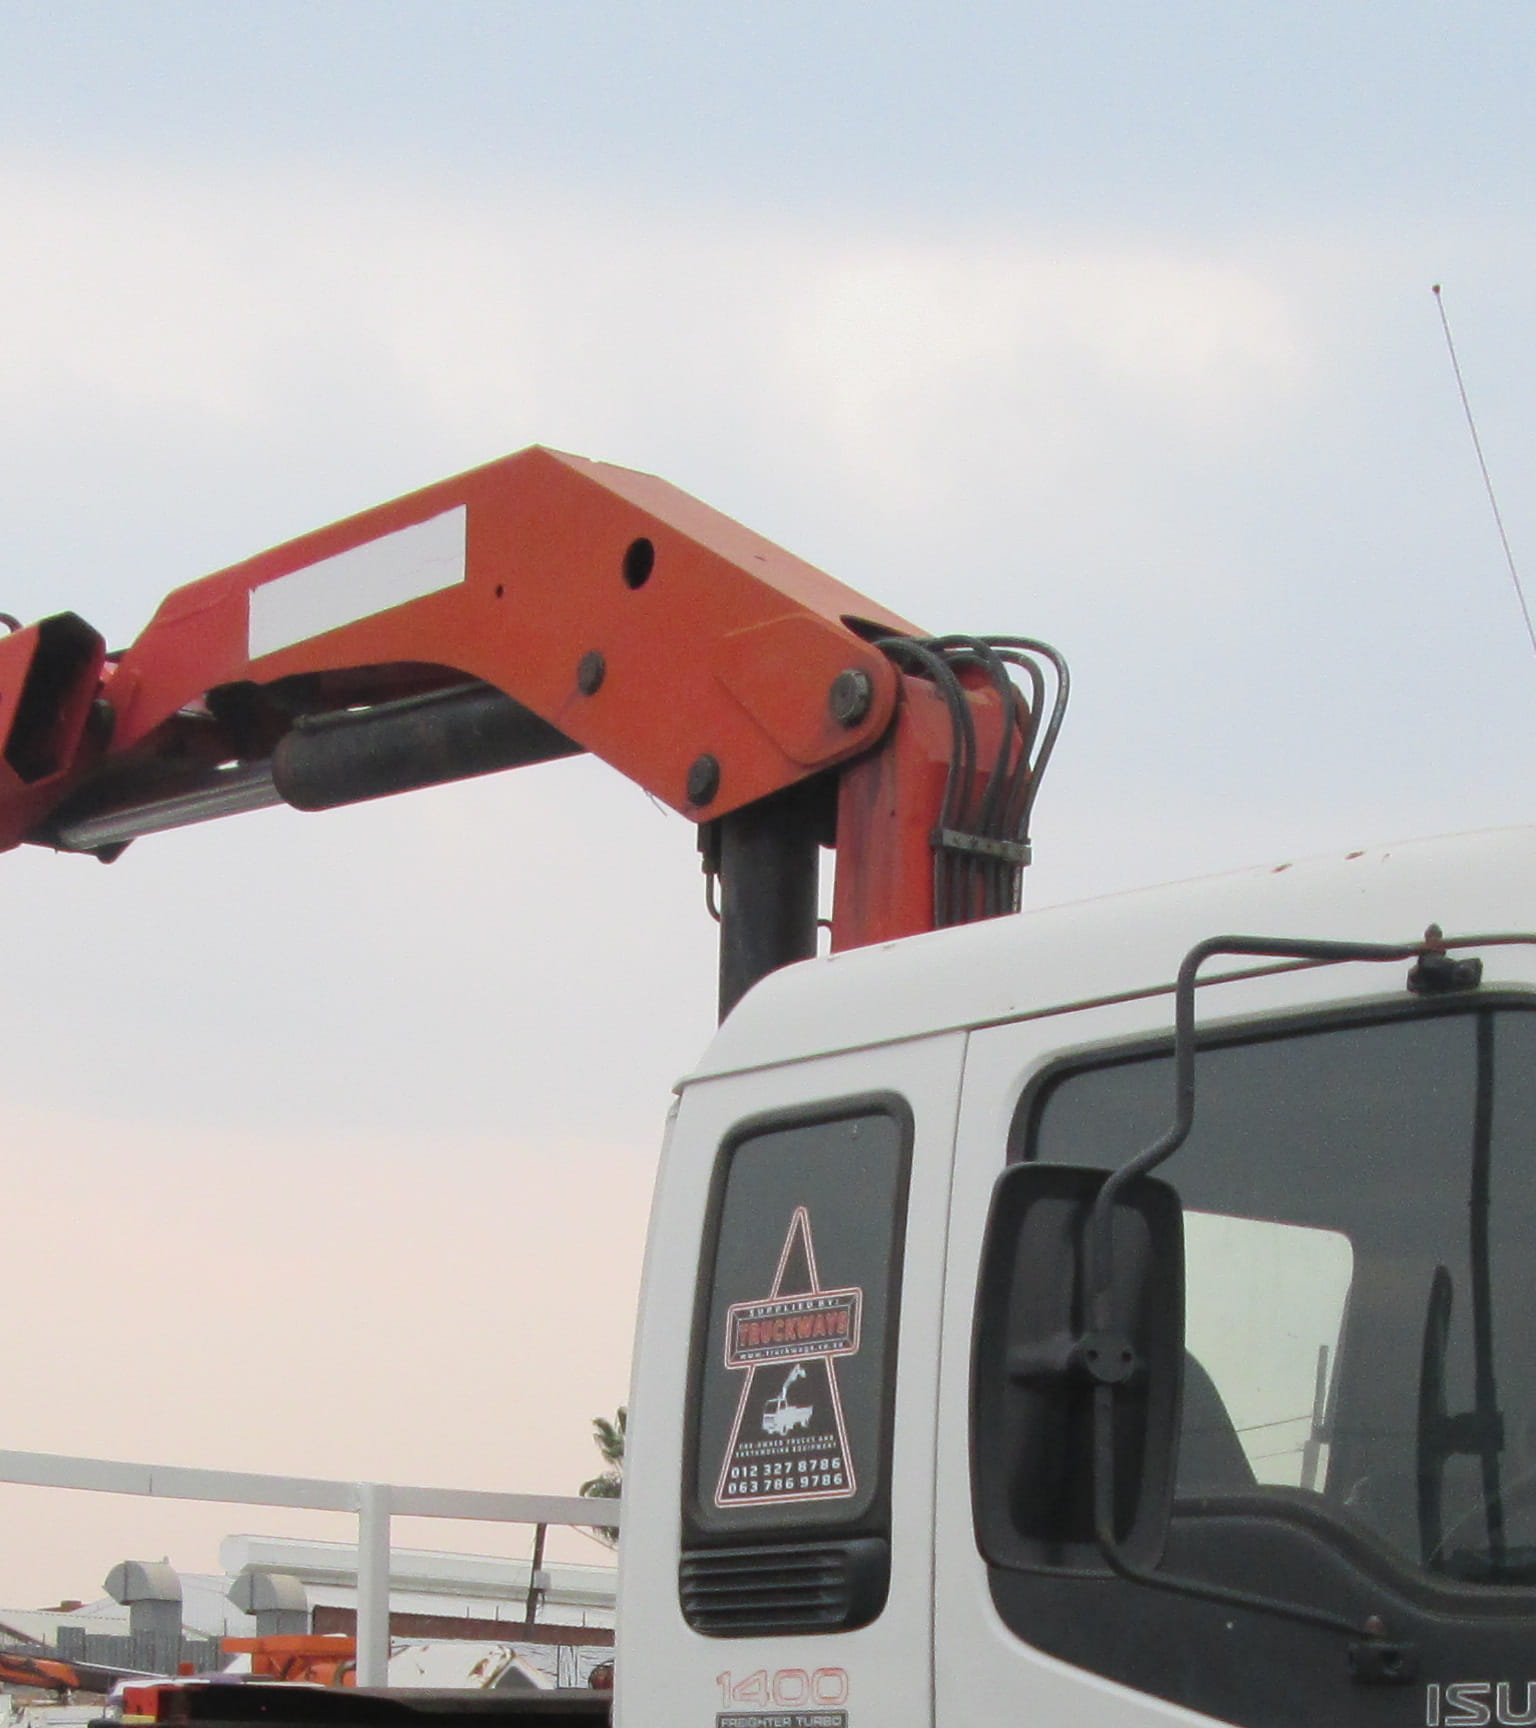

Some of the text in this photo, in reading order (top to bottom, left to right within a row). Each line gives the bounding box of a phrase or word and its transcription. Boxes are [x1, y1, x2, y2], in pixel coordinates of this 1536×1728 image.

[749, 1300, 814, 1317] SUPPLIED
[739, 1310, 848, 1346] TRUCKWAYS
[731, 1457, 841, 1478] 012 327 8786
[728, 1473, 843, 1494] 063 786 9786
[716, 1667, 849, 1708] 1400
[721, 1714, 843, 1728] FREIGHTER TURBO
